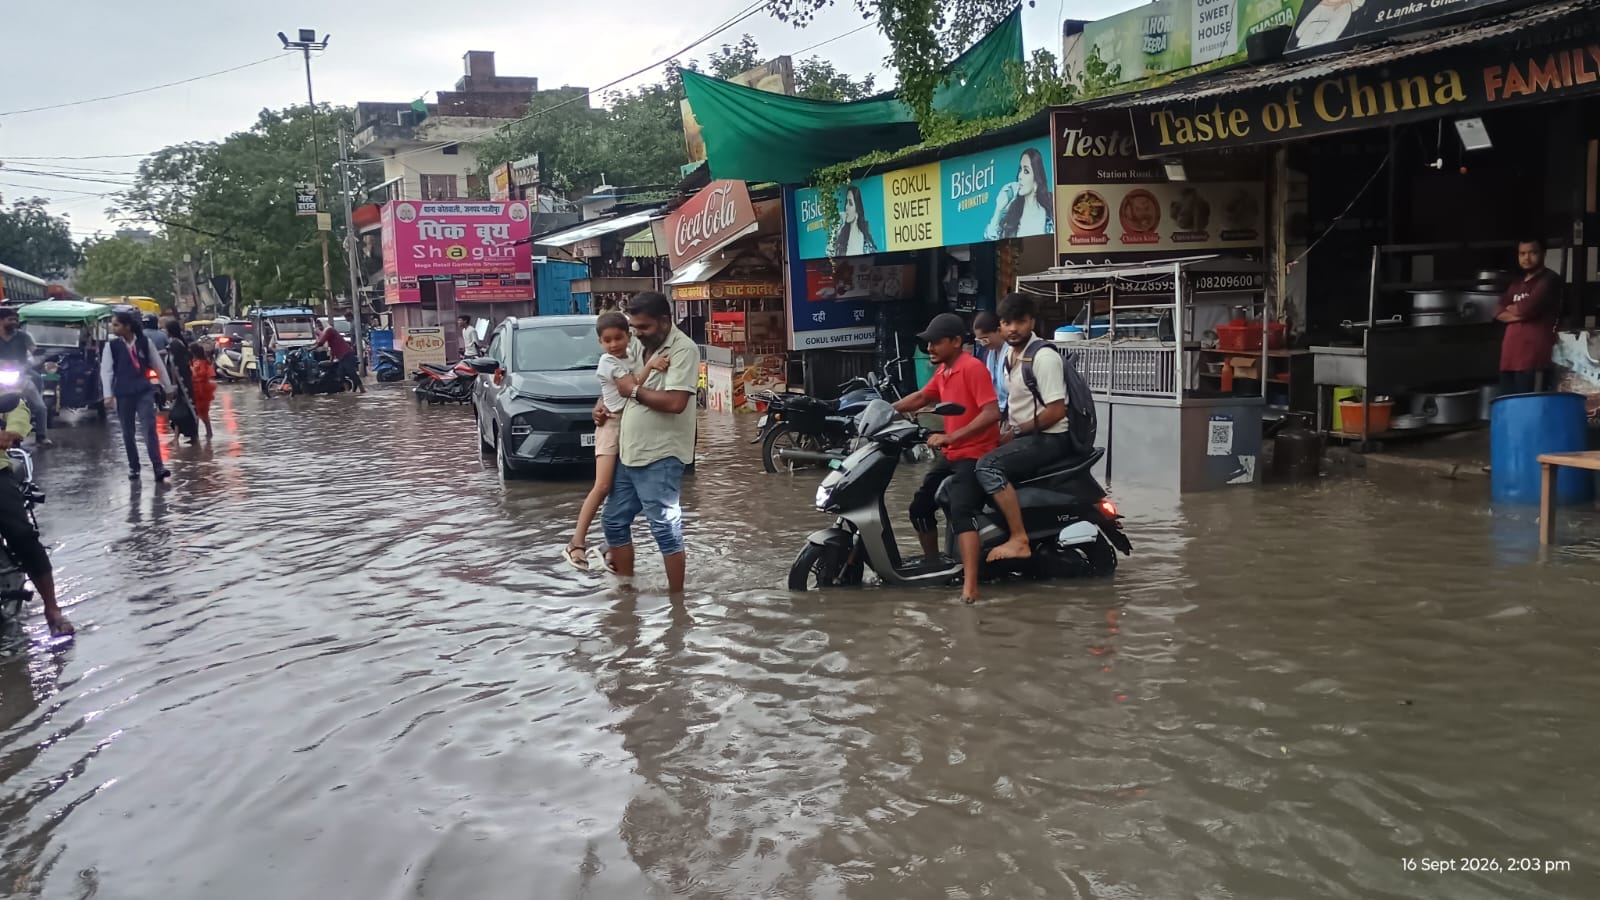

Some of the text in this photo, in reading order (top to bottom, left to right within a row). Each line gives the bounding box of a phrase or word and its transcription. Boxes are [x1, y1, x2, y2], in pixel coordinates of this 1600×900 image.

[1200, 4, 1229, 24] SWEET
[1198, 21, 1231, 41] HOUSE
[1151, 102, 1250, 146] Taste
[1262, 86, 1303, 132] of
[1313, 69, 1467, 122] China
[892, 173, 930, 196] GOKUL
[951, 159, 995, 200] Bisleri
[1097, 169, 1127, 179] Station
[893, 197, 930, 220] SWEET
[416, 220, 510, 247] पिंक बूथ
[894, 222, 933, 244] HOUSE
[413, 246, 516, 260] Shagun
[812, 310, 826, 322] दही
[805, 332, 876, 345] GOKUL SWEET HOUSE
